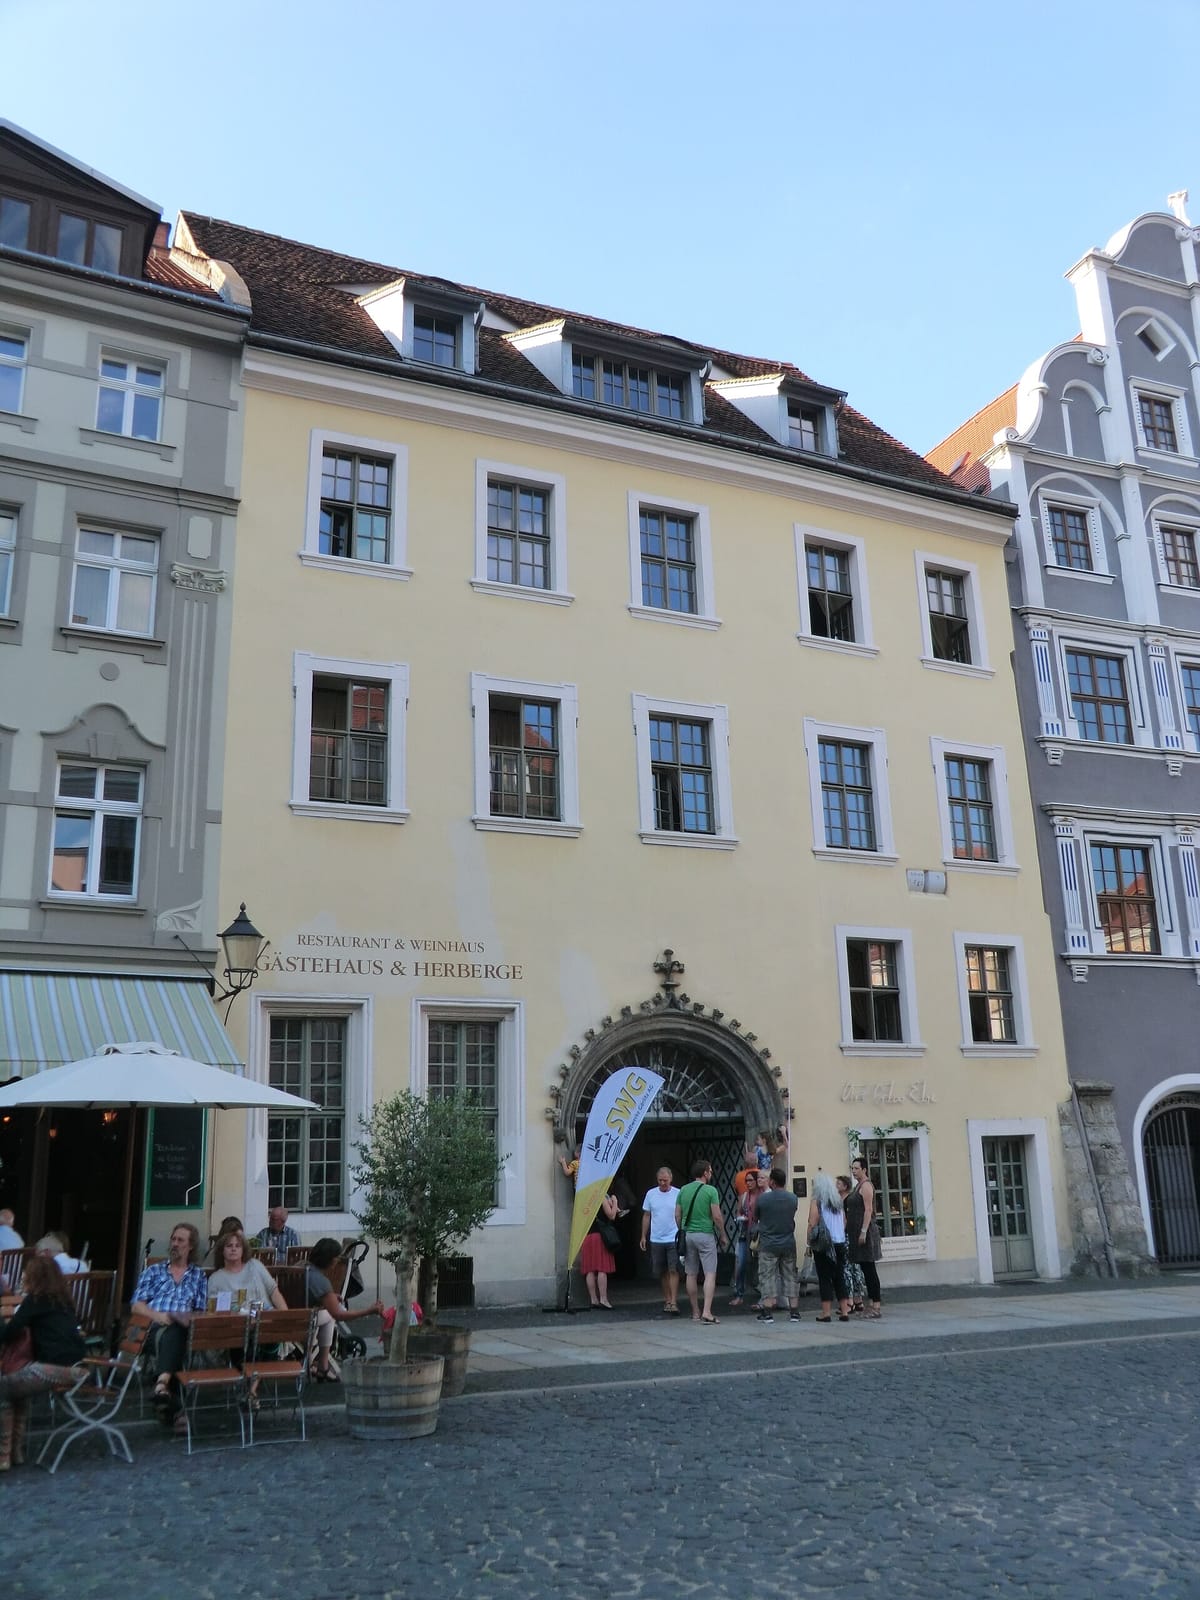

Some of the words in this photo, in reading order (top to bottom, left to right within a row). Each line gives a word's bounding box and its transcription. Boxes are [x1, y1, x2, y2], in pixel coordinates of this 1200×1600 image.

[297, 934, 390, 950] RESTAURANT
[394, 938, 406, 950] &
[410, 939, 485, 953] WEINHAUS
[255, 951, 384, 976] GÄSTEHAUS
[390, 960, 407, 977] &
[413, 961, 523, 980] HERBERGE
[605, 1071, 648, 1136] SWG
